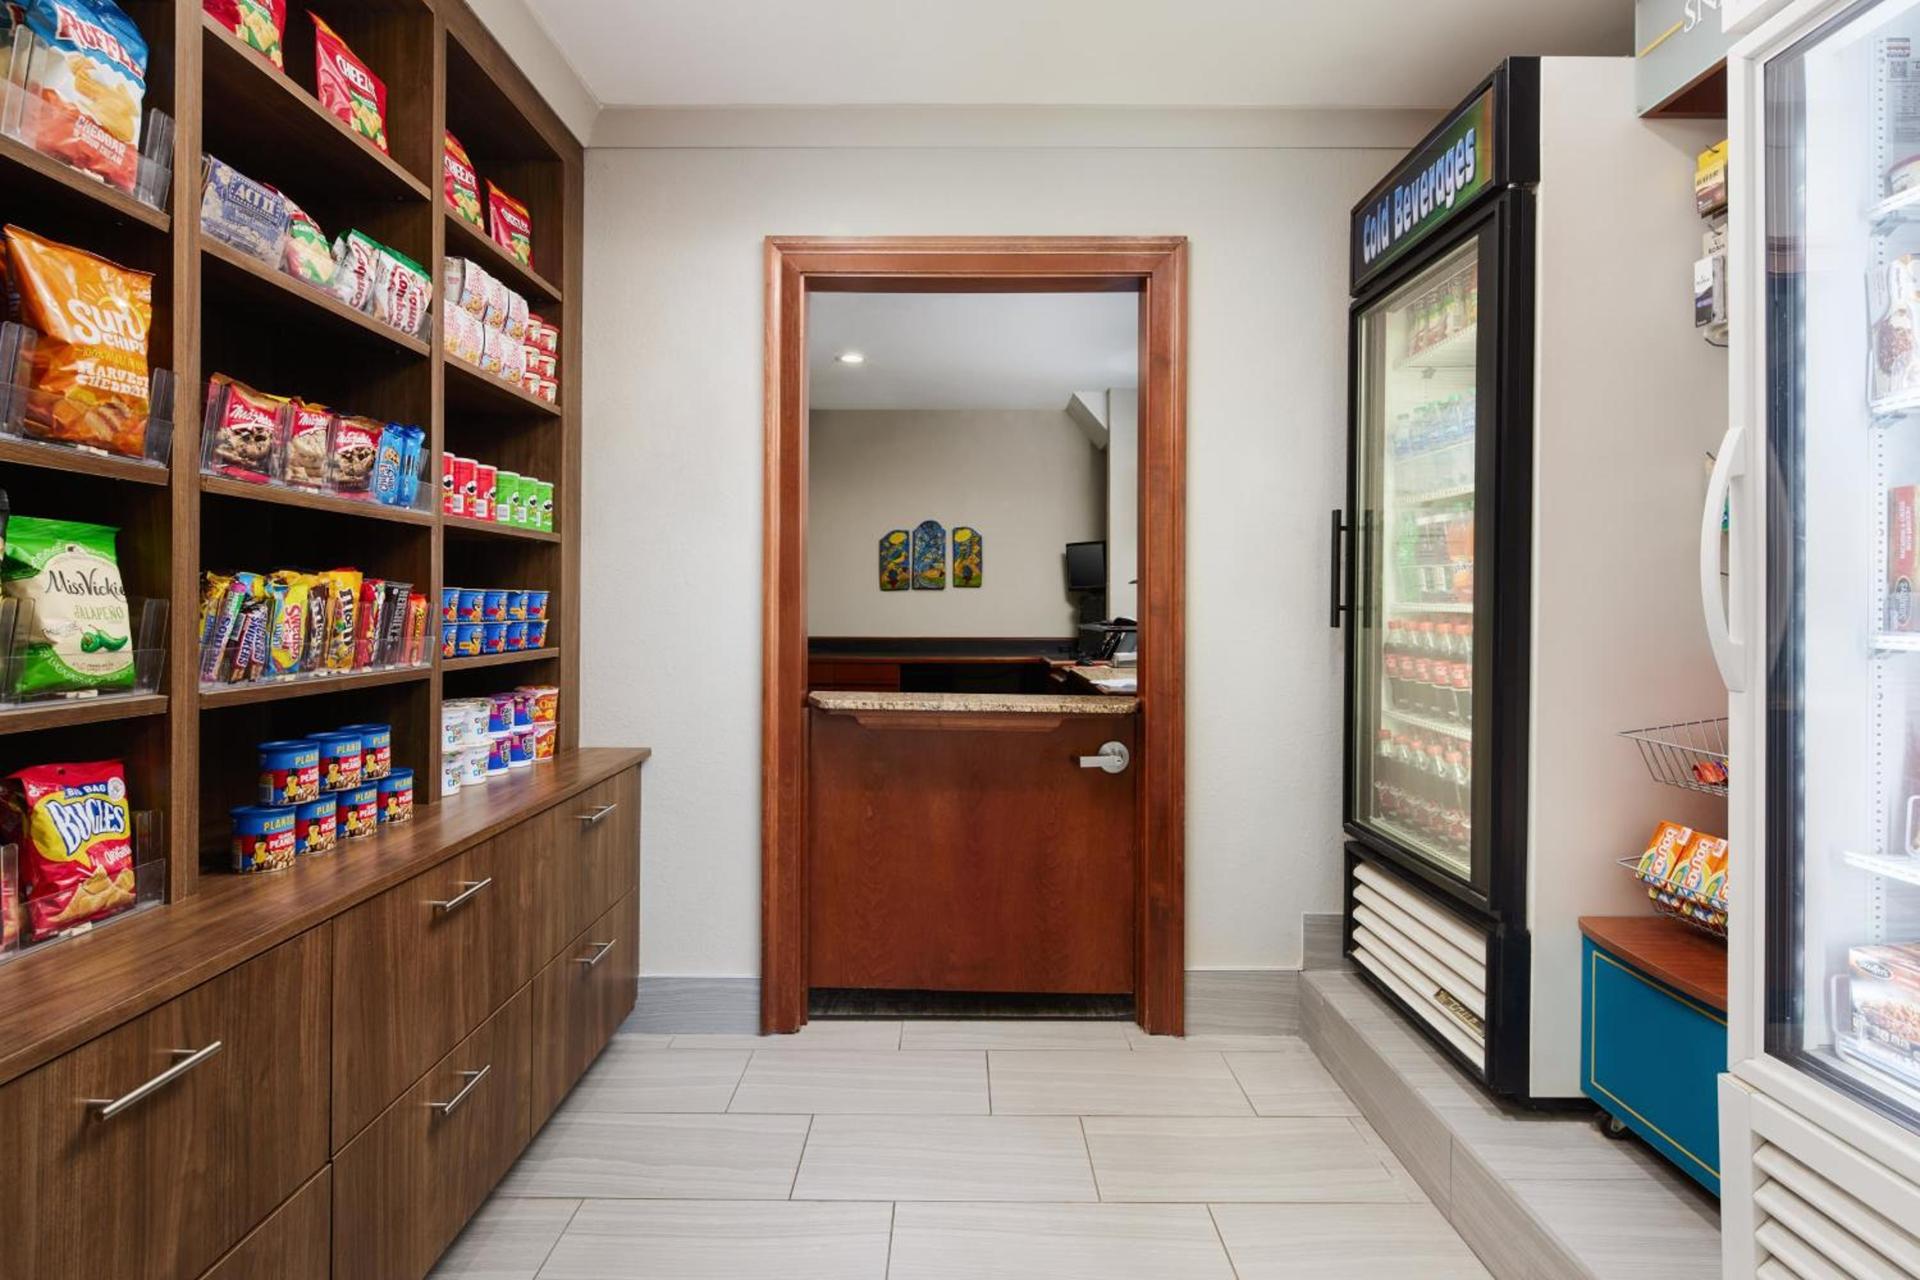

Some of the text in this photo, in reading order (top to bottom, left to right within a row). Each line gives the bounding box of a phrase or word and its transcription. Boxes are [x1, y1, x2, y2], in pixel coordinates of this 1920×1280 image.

[1363, 127, 1476, 264] Cold Beverages
[237, 615, 259, 666] SNICKERS
[284, 604, 303, 661] Swedish
[84, 784, 107, 794] BAG
[45, 798, 125, 857] BUGLES
